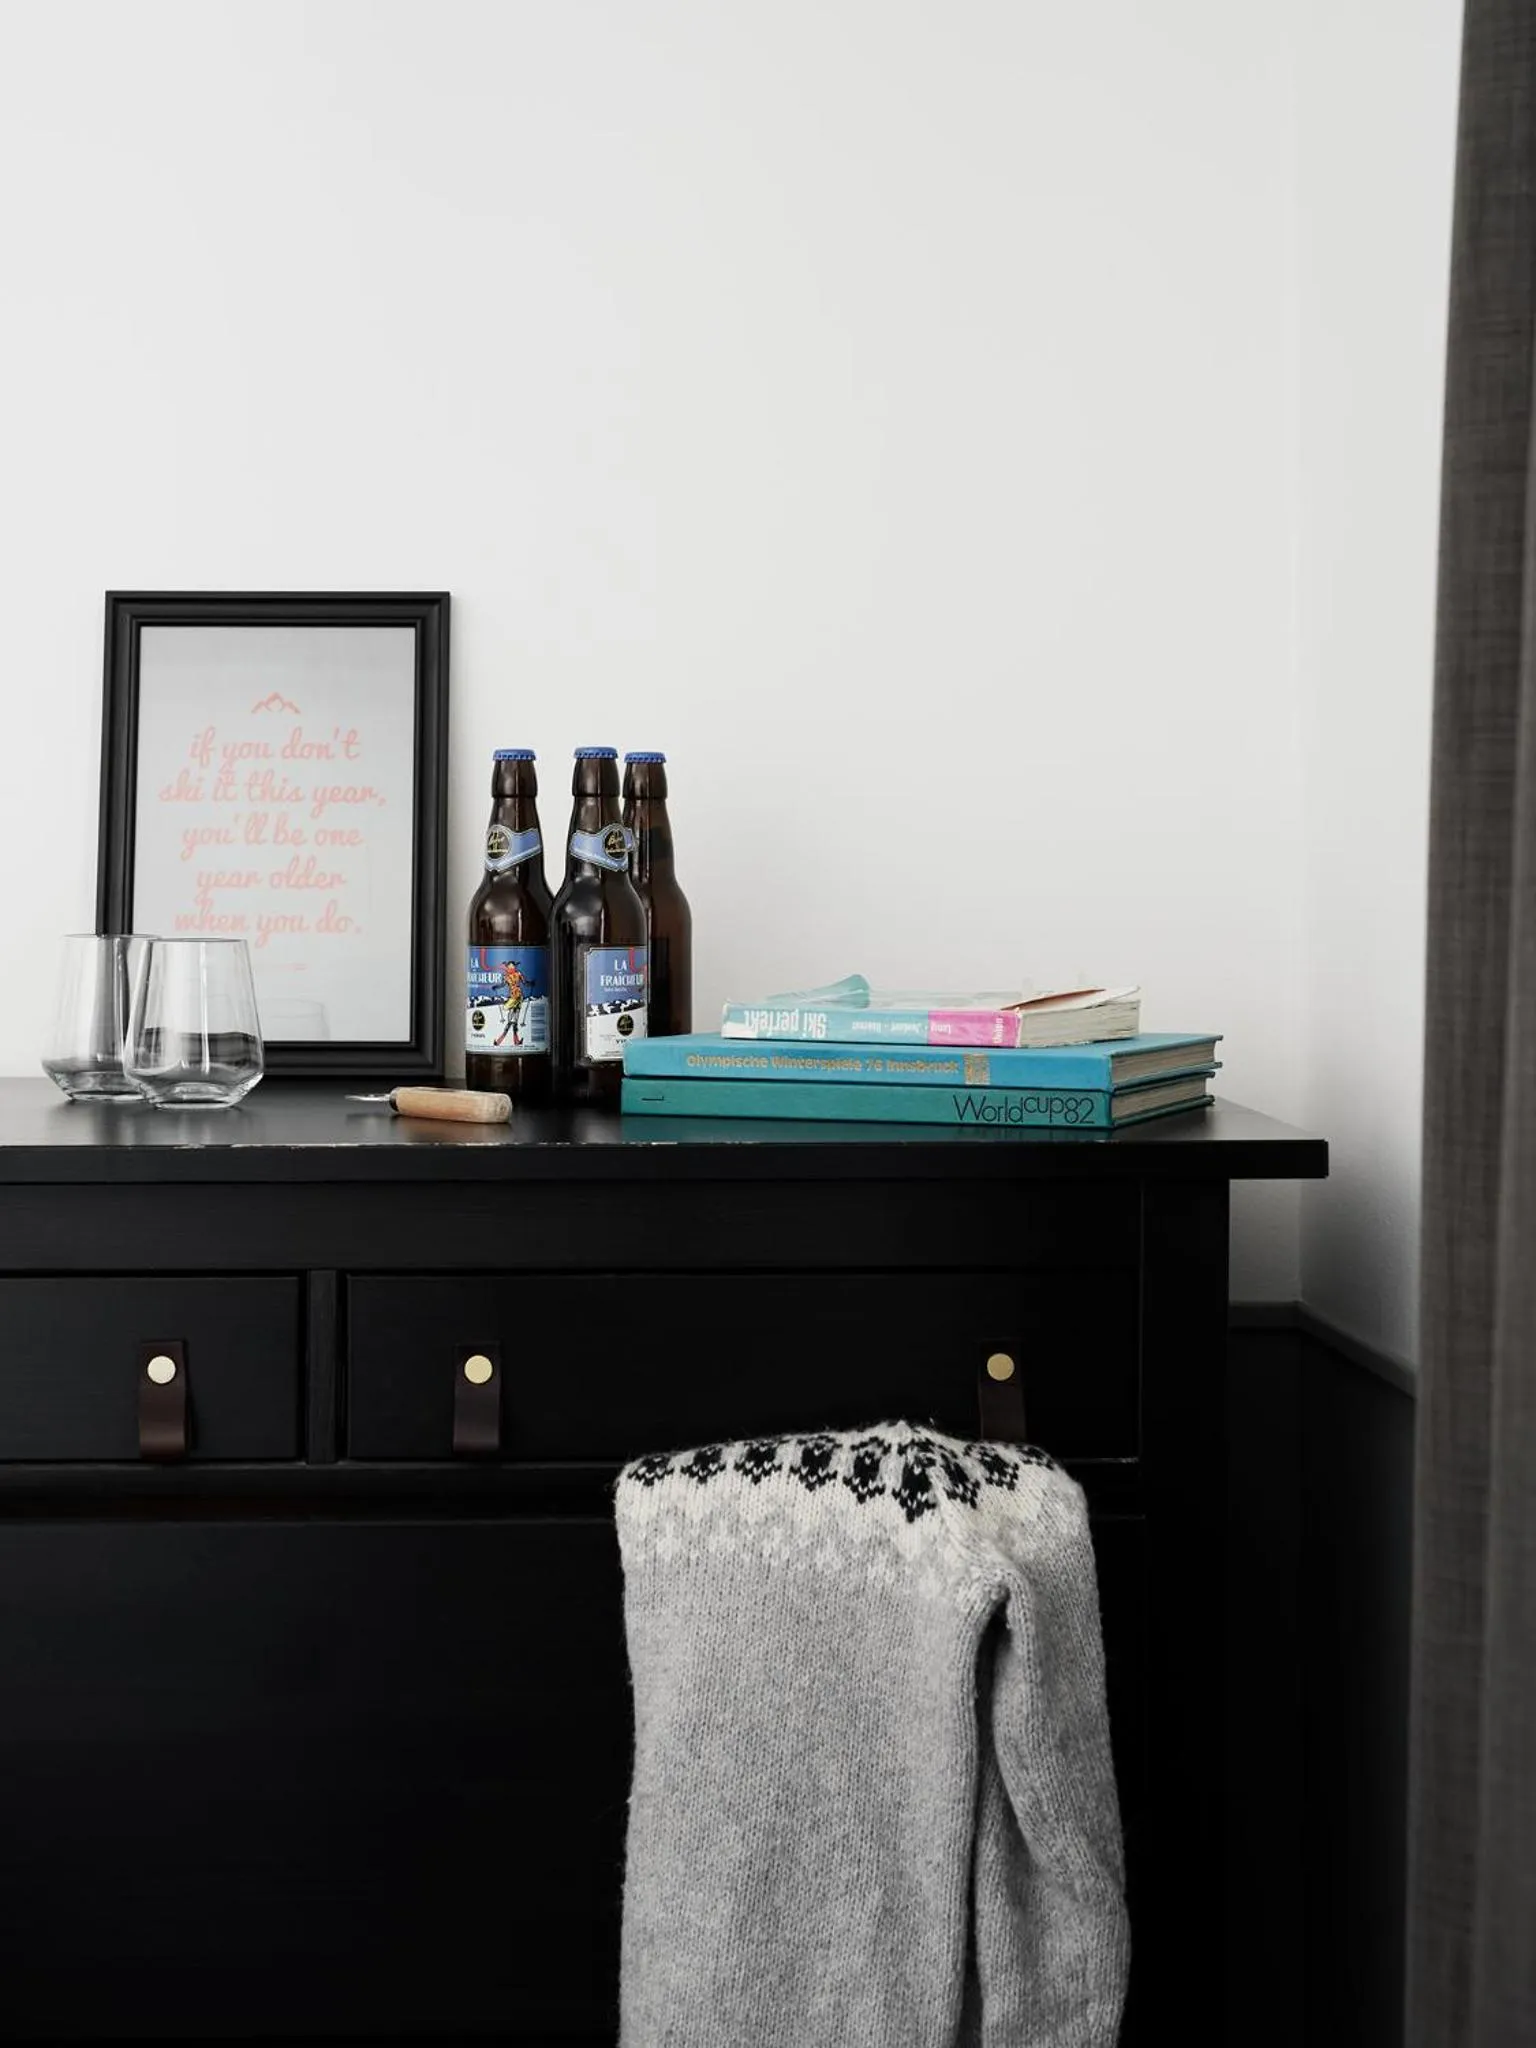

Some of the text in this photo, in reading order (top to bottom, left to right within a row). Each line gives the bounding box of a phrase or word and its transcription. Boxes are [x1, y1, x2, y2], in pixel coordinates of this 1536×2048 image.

[189, 725, 361, 774] if you don't
[158, 767, 387, 819] ski it this year,
[180, 811, 363, 861] you'll be one
[194, 855, 347, 906] year older
[174, 899, 362, 949] when you do.
[614, 959, 628, 971] LA
[743, 1009, 801, 1037] perfekt
[803, 1011, 827, 1039] Ski
[687, 1054, 769, 1070] Olympische
[772, 1056, 862, 1072] Winterspiele
[887, 1059, 959, 1074] Innsbruck
